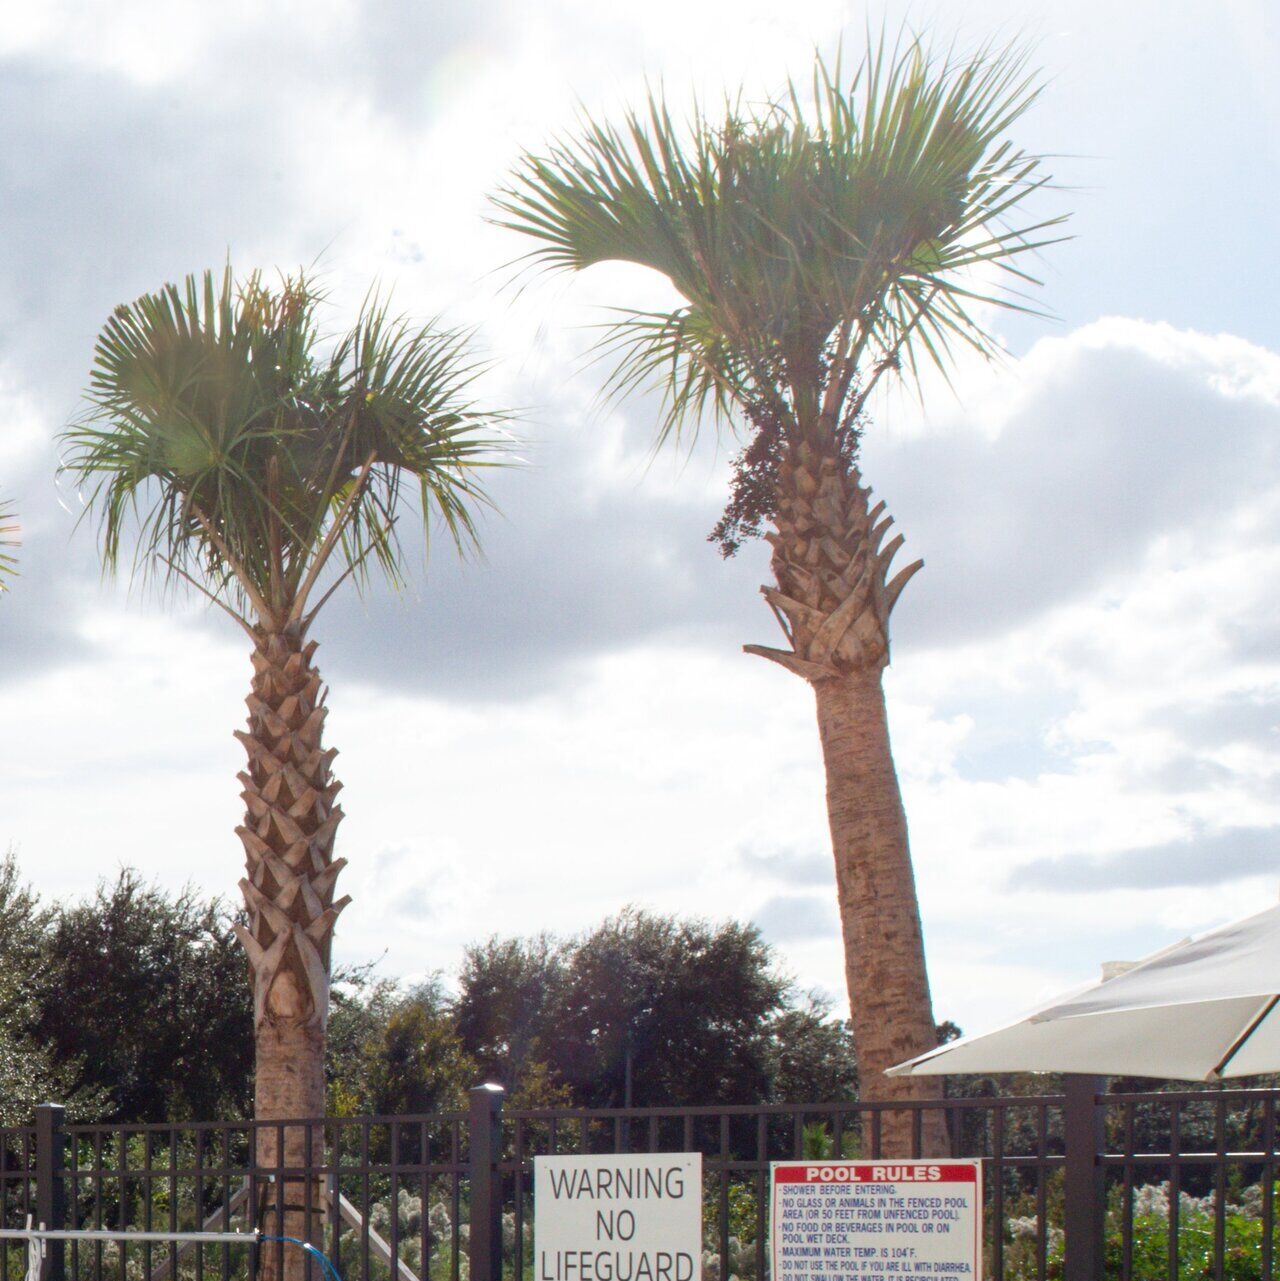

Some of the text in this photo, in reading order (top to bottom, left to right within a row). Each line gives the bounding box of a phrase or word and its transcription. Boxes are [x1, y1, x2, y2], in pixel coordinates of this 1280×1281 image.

[806, 1166, 942, 1182] POOL RULES
[550, 1167, 683, 1199] WARNING
[782, 1184, 816, 1195] SHOWER
[820, 1184, 852, 1195] BEFORE
[782, 1198, 968, 1208] NO GLASS OR ANIMALS IN THE FENCED POOL
[782, 1209, 803, 1219] AREA
[822, 1209, 833, 1219] 50
[835, 1209, 855, 1219] FEET
[857, 1209, 881, 1219] FROM
[883, 1209, 929, 1220] UNFENCED
[597, 1210, 635, 1241] NO
[782, 1222, 950, 1233] NO FOOD OR BEVERAGES IN POOL OR ON
[782, 1233, 850, 1244] POOL WET DECK.
[782, 1246, 821, 1257] MAXIMUM
[824, 1247, 851, 1257] WATER
[854, 1247, 878, 1257] TEMP.
[880, 1247, 889, 1258] IS
[782, 1260, 793, 1270] DO
[794, 1260, 808, 1270] NOT
[810, 1261, 823, 1271] USE
[825, 1261, 838, 1271] THE
[840, 1261, 860, 1271] POOL
[861, 1261, 867, 1271] IF
[869, 1261, 884, 1271] YOU
[886, 1261, 900, 1271] ARE
[902, 1262, 912, 1272] ILL
[914, 1262, 932, 1272] WITH
